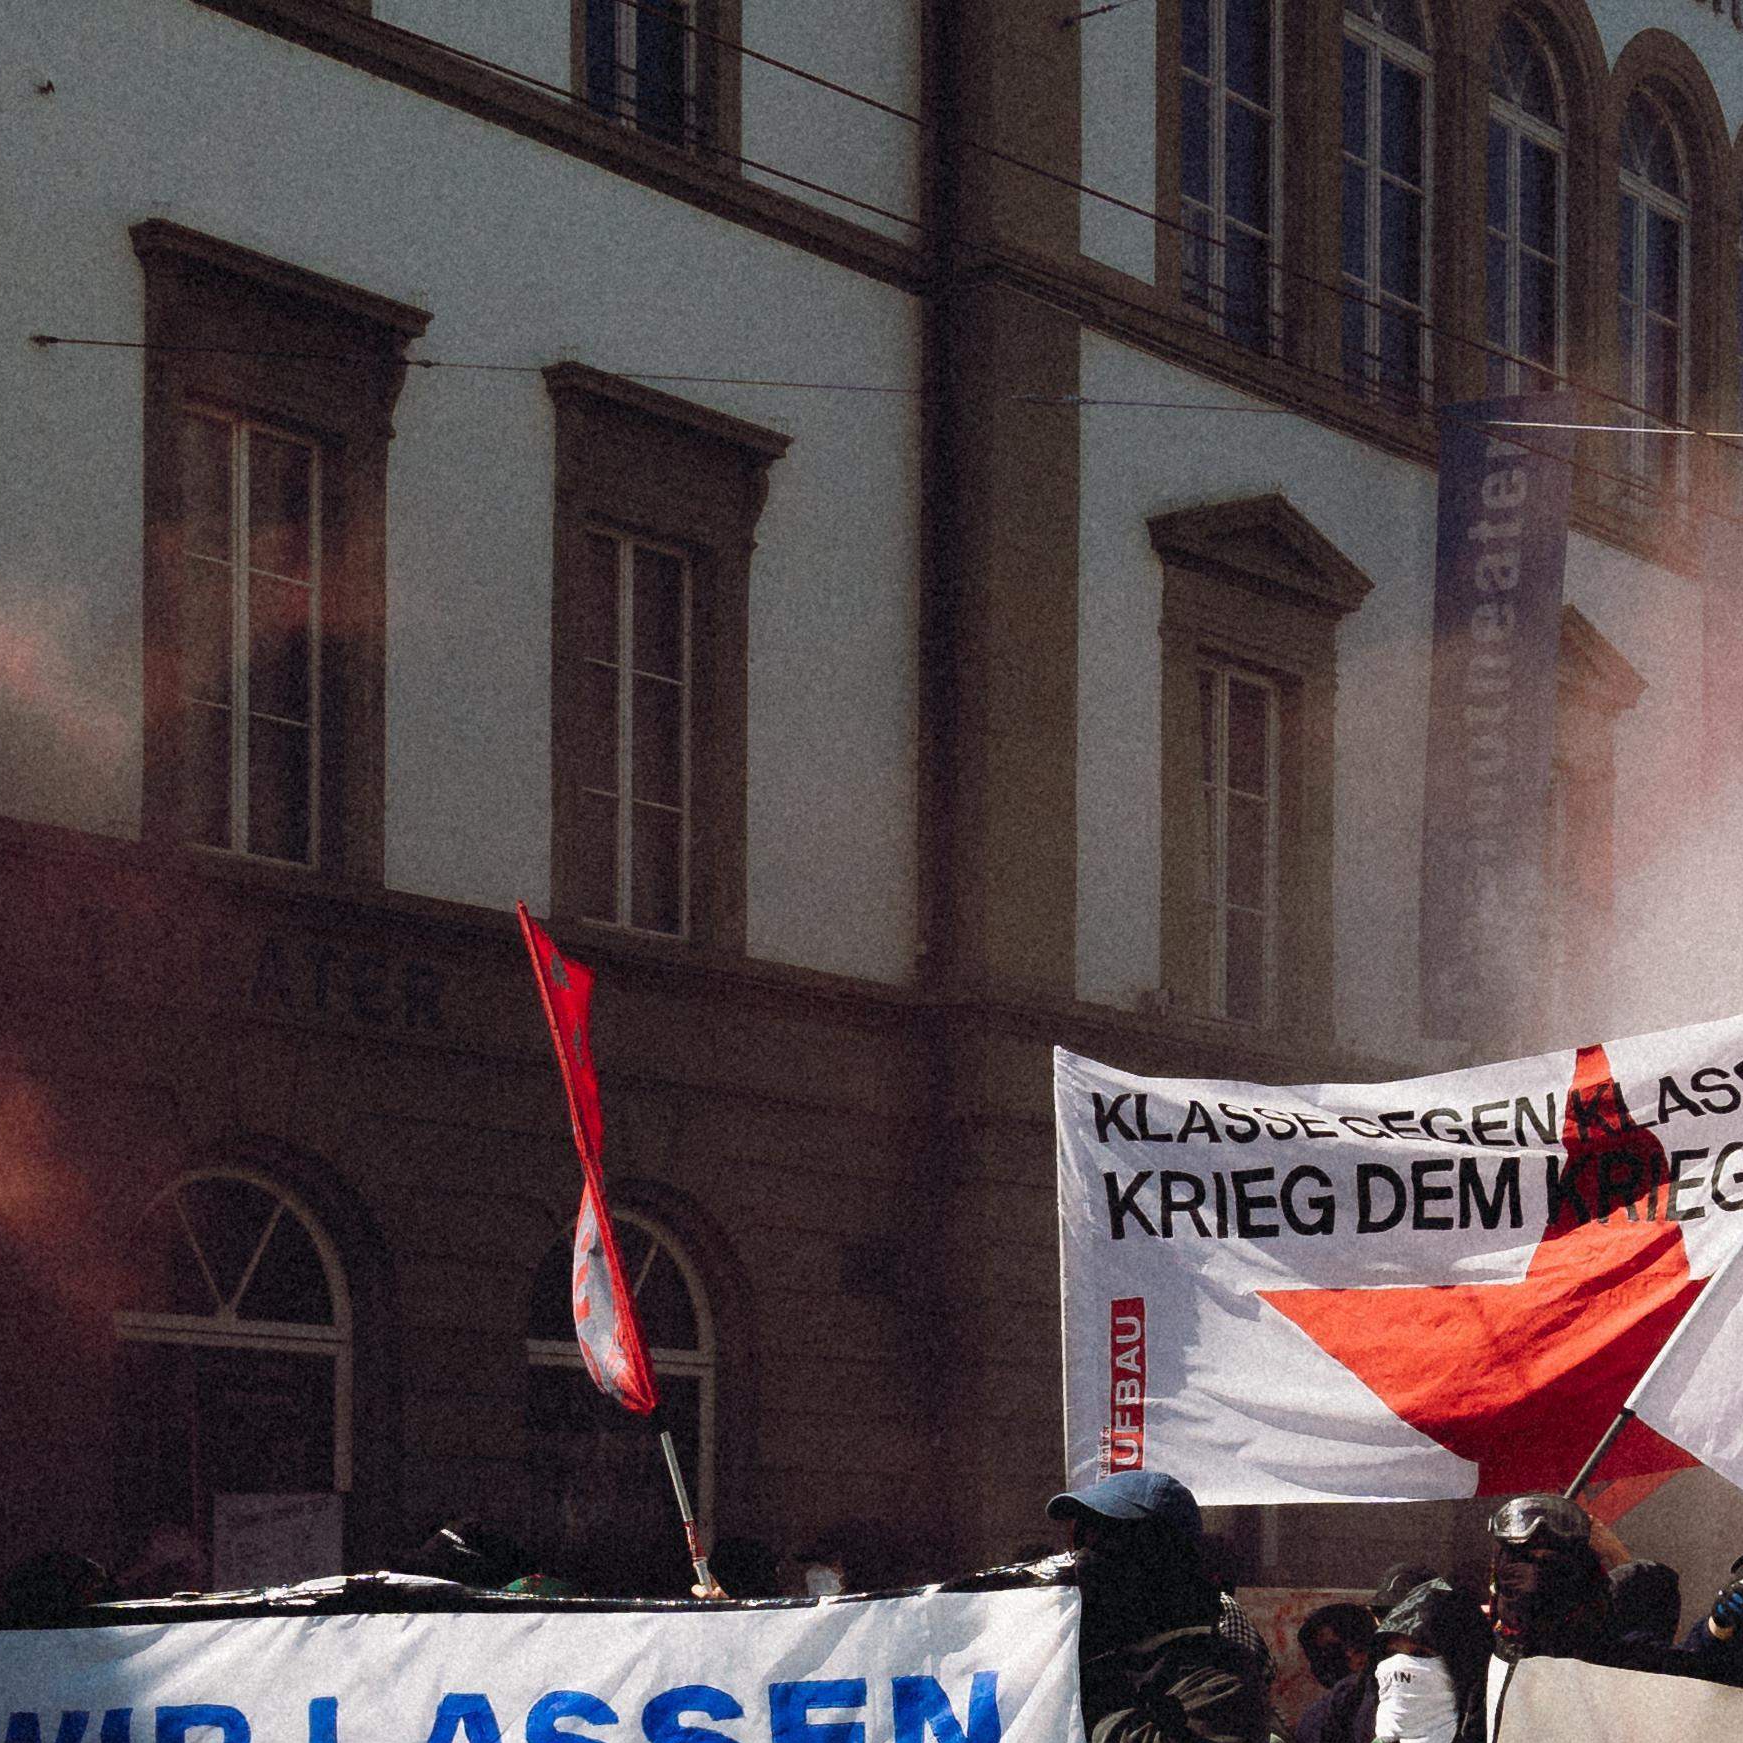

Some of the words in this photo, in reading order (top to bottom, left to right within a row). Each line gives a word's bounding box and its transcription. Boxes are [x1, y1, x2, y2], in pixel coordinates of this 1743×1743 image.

[1091, 1091, 1338, 1144] KLASSE
[1338, 1091, 1560, 1147] GEGEN
[1102, 1164, 1337, 1240] KRIEG
[1356, 1156, 1524, 1234] DEM
[1115, 1315, 1142, 1467] UFBAU
